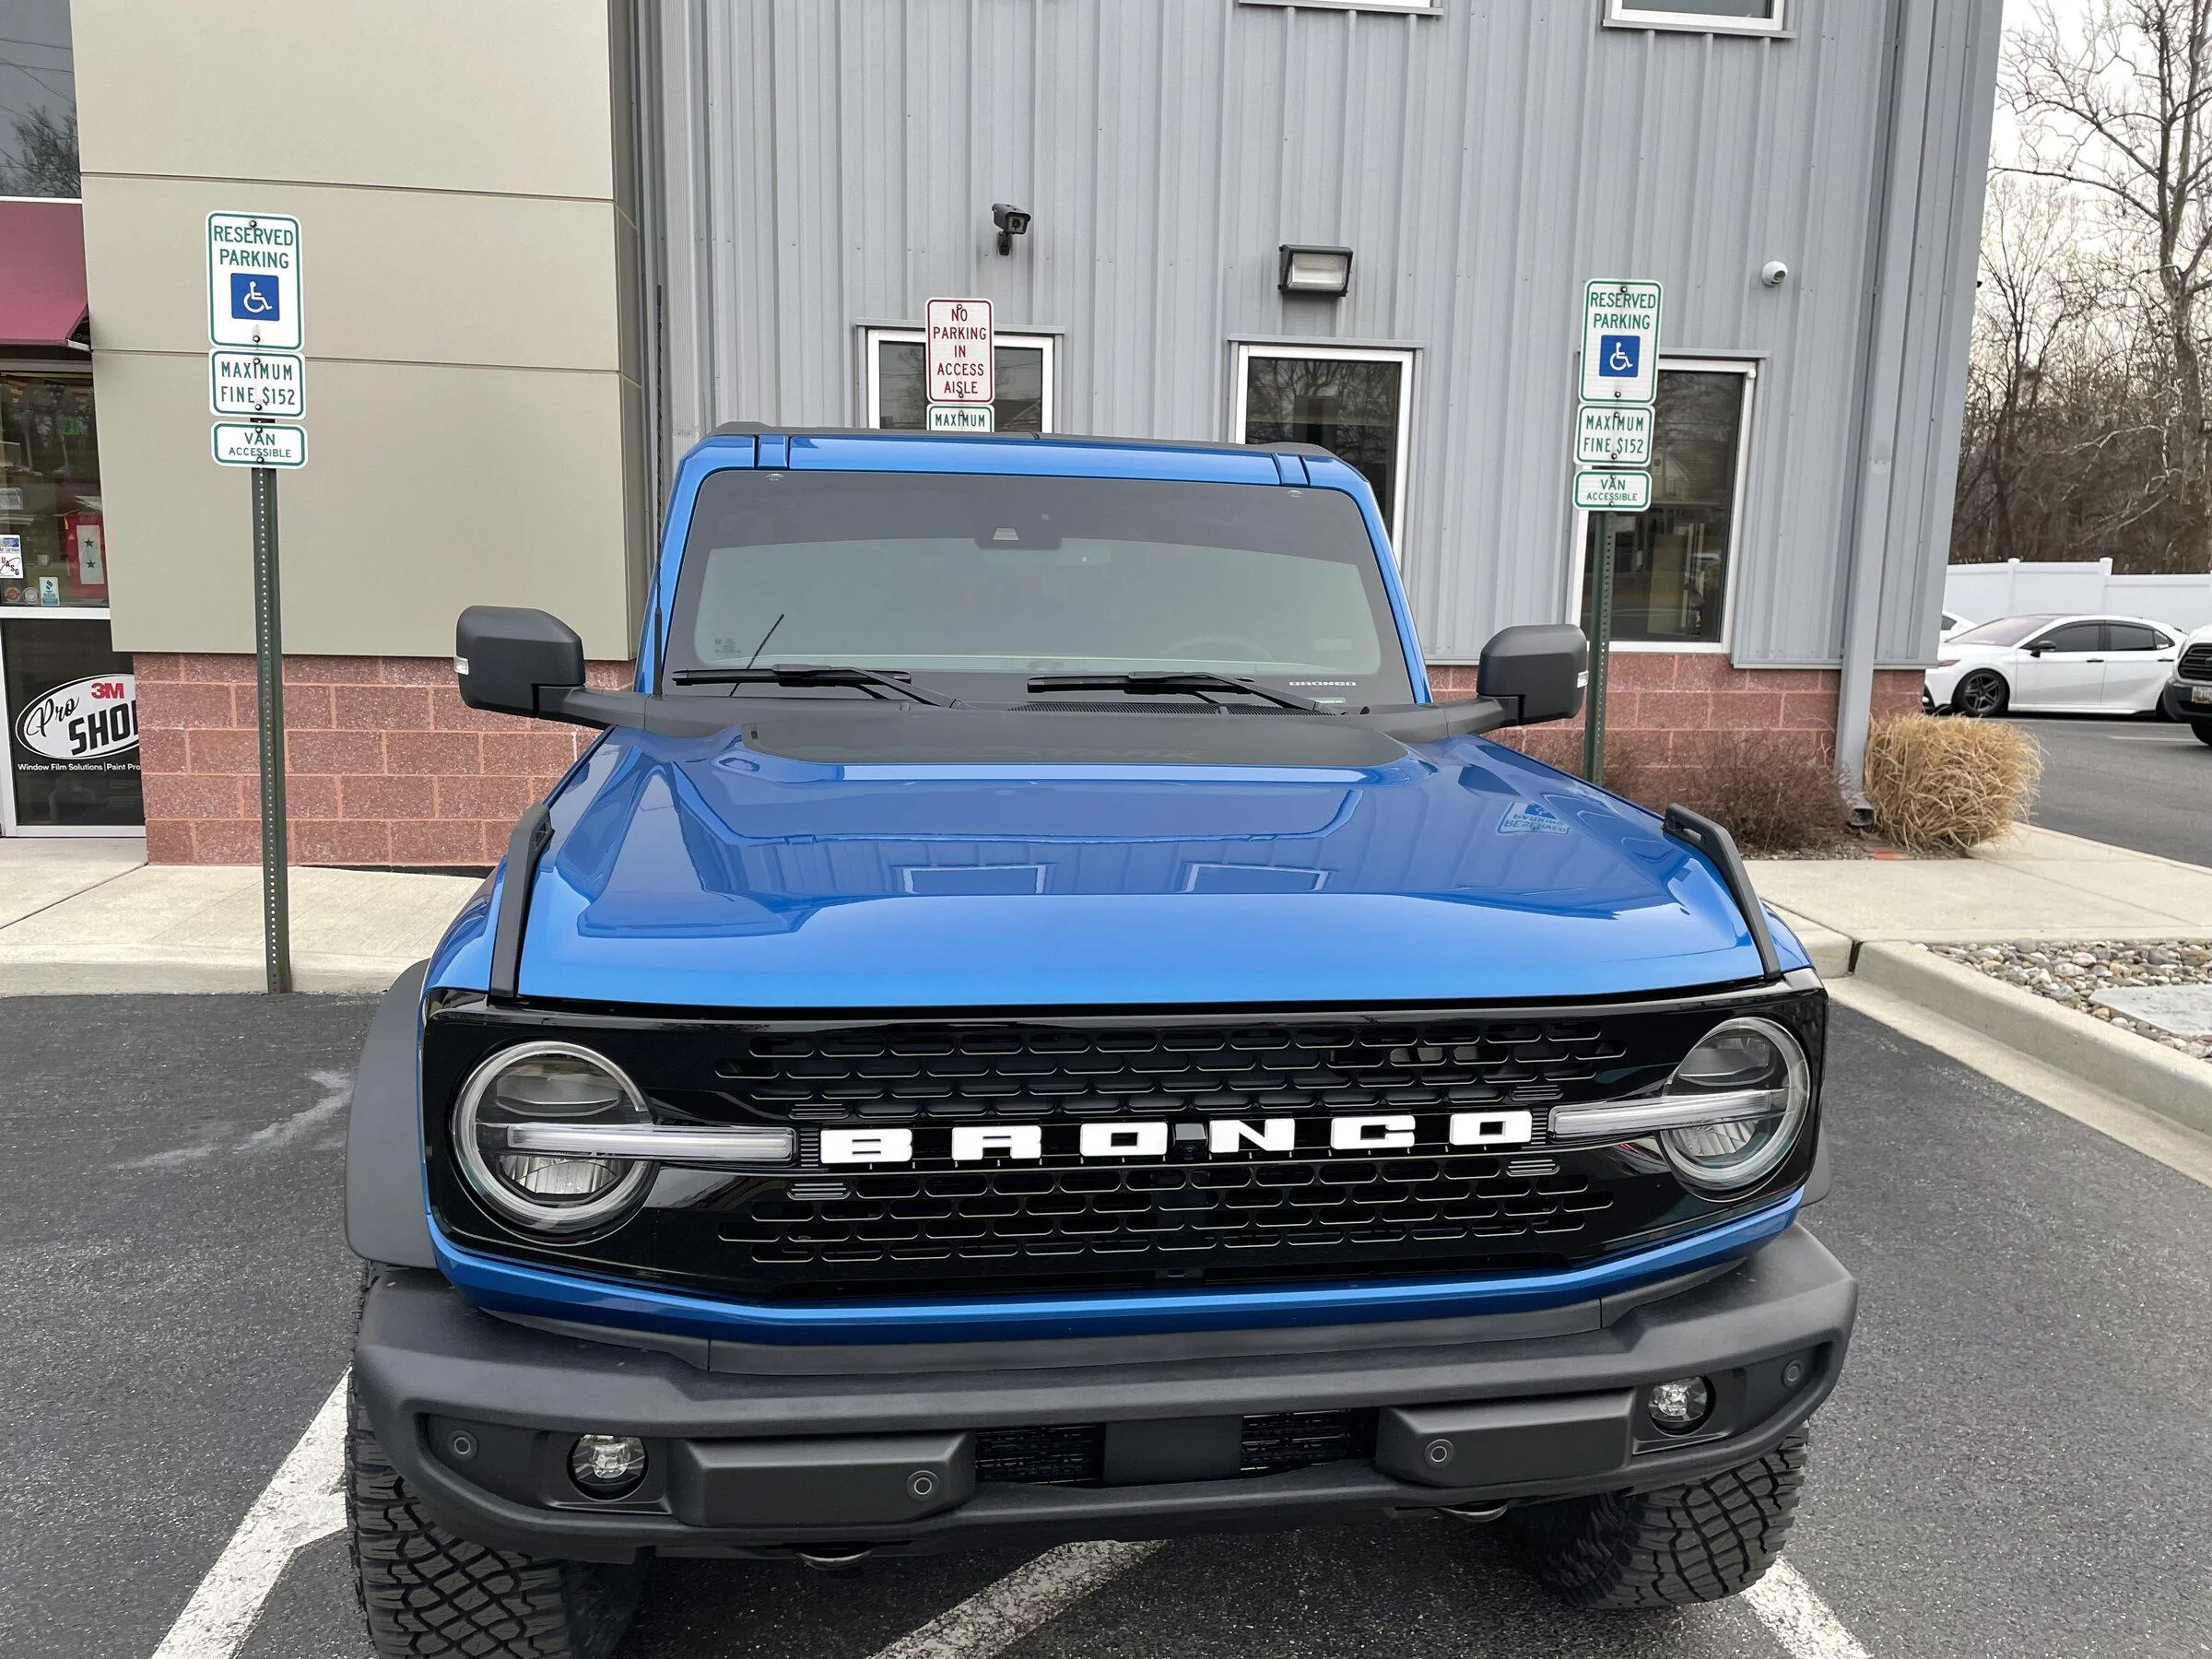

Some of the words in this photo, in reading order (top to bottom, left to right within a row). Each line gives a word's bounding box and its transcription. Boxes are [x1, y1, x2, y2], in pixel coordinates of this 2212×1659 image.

[214, 226, 294, 246] RESERVED
[219, 249, 289, 269] PARKING
[1590, 292, 1656, 309] RESERVED
[951, 309, 968, 322] NO
[1594, 313, 1650, 330] PARKING
[933, 326, 987, 340] PARKING
[954, 345, 966, 358] IN
[221, 361, 292, 381] MAXIMUM
[937, 362, 984, 376] ACCESS
[944, 381, 978, 394] AISLE
[221, 386, 255, 404] FINE
[262, 386, 295, 406] $152
[935, 413, 985, 427] MAXIMUM
[1586, 416, 1643, 430] MAXIMUM
[244, 432, 276, 446] VAN
[1583, 438, 1610, 453] FINE
[1617, 438, 1643, 453] $152
[229, 447, 291, 458] ACCESSIBLE
[1600, 479, 1626, 490] VAN
[1586, 492, 1638, 501] ACCESSIBLE
[91, 682, 124, 700] 3M
[26, 697, 80, 737] Pro
[107, 763, 125, 771] Paint
[820, 1111, 1532, 1164] BRONCO
